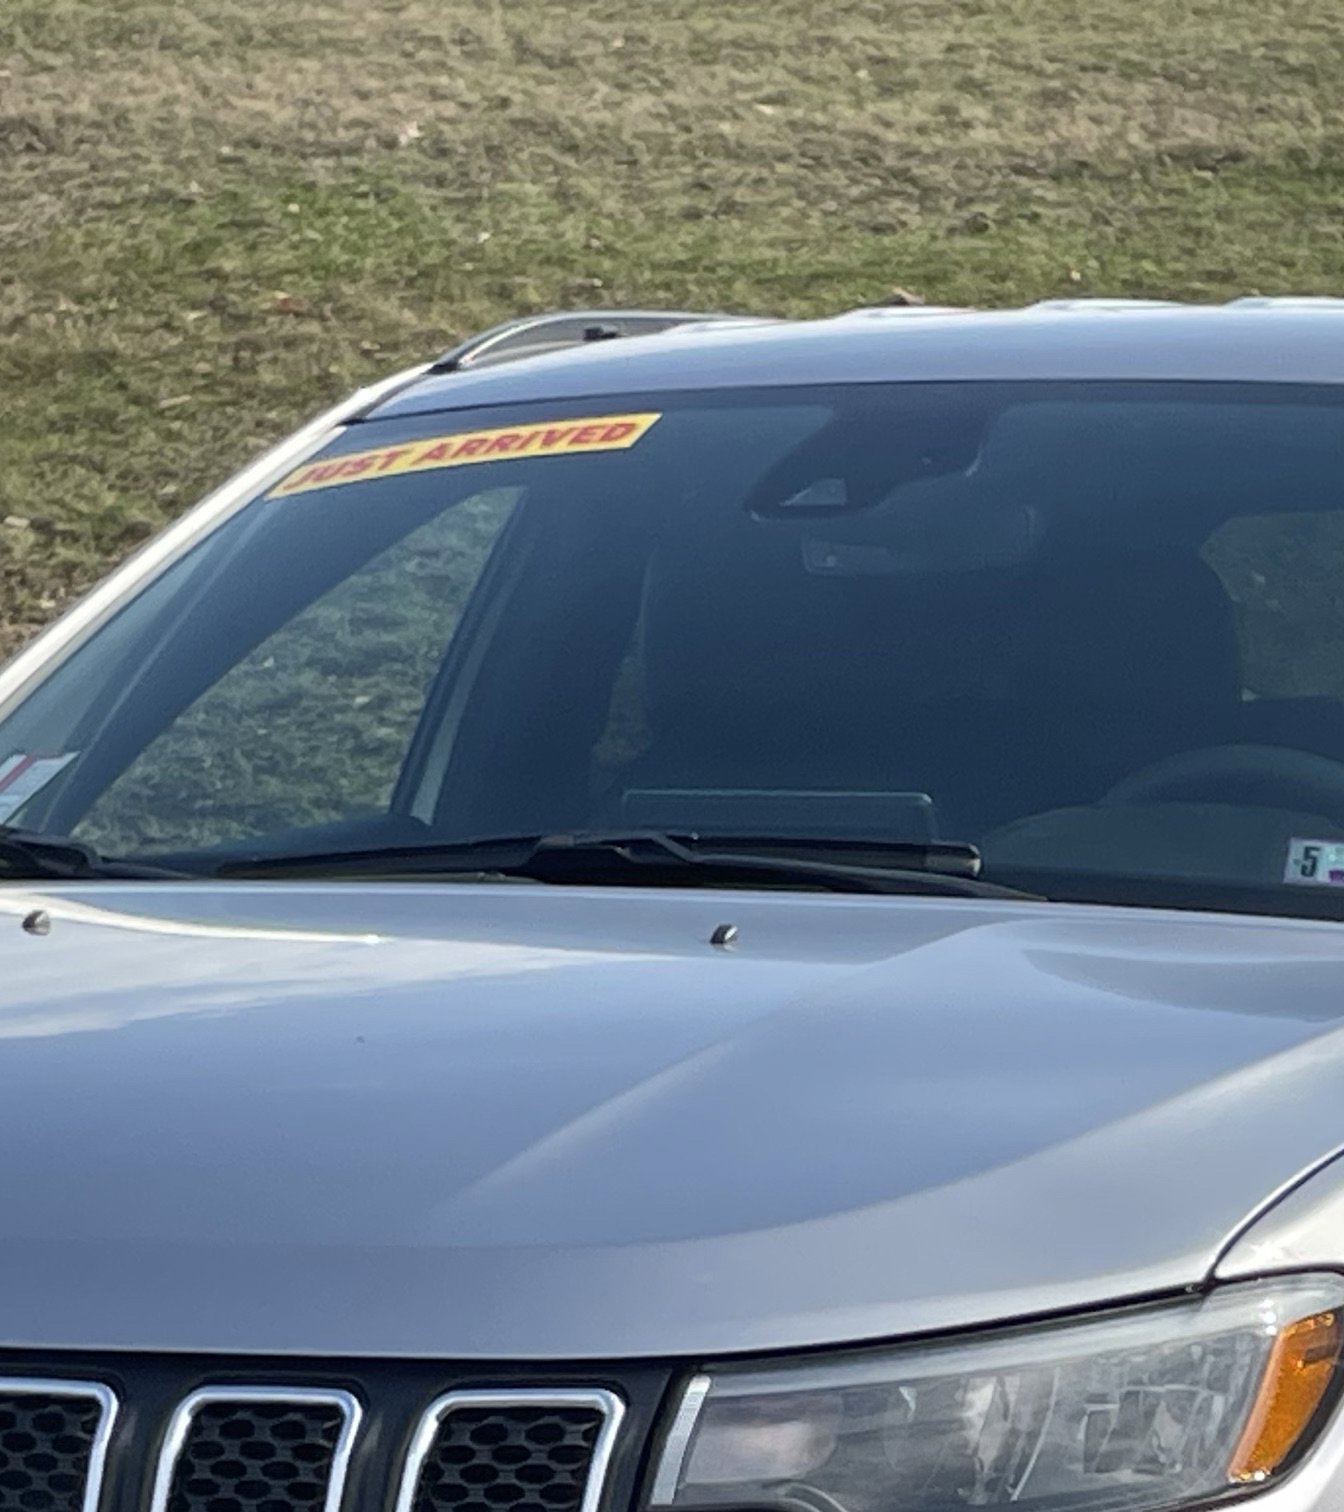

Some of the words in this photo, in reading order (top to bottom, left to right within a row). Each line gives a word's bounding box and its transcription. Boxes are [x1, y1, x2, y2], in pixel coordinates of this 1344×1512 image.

[283, 448, 412, 490] JUST
[415, 422, 640, 465] ARRIVED
[1300, 847, 1320, 877] 5
